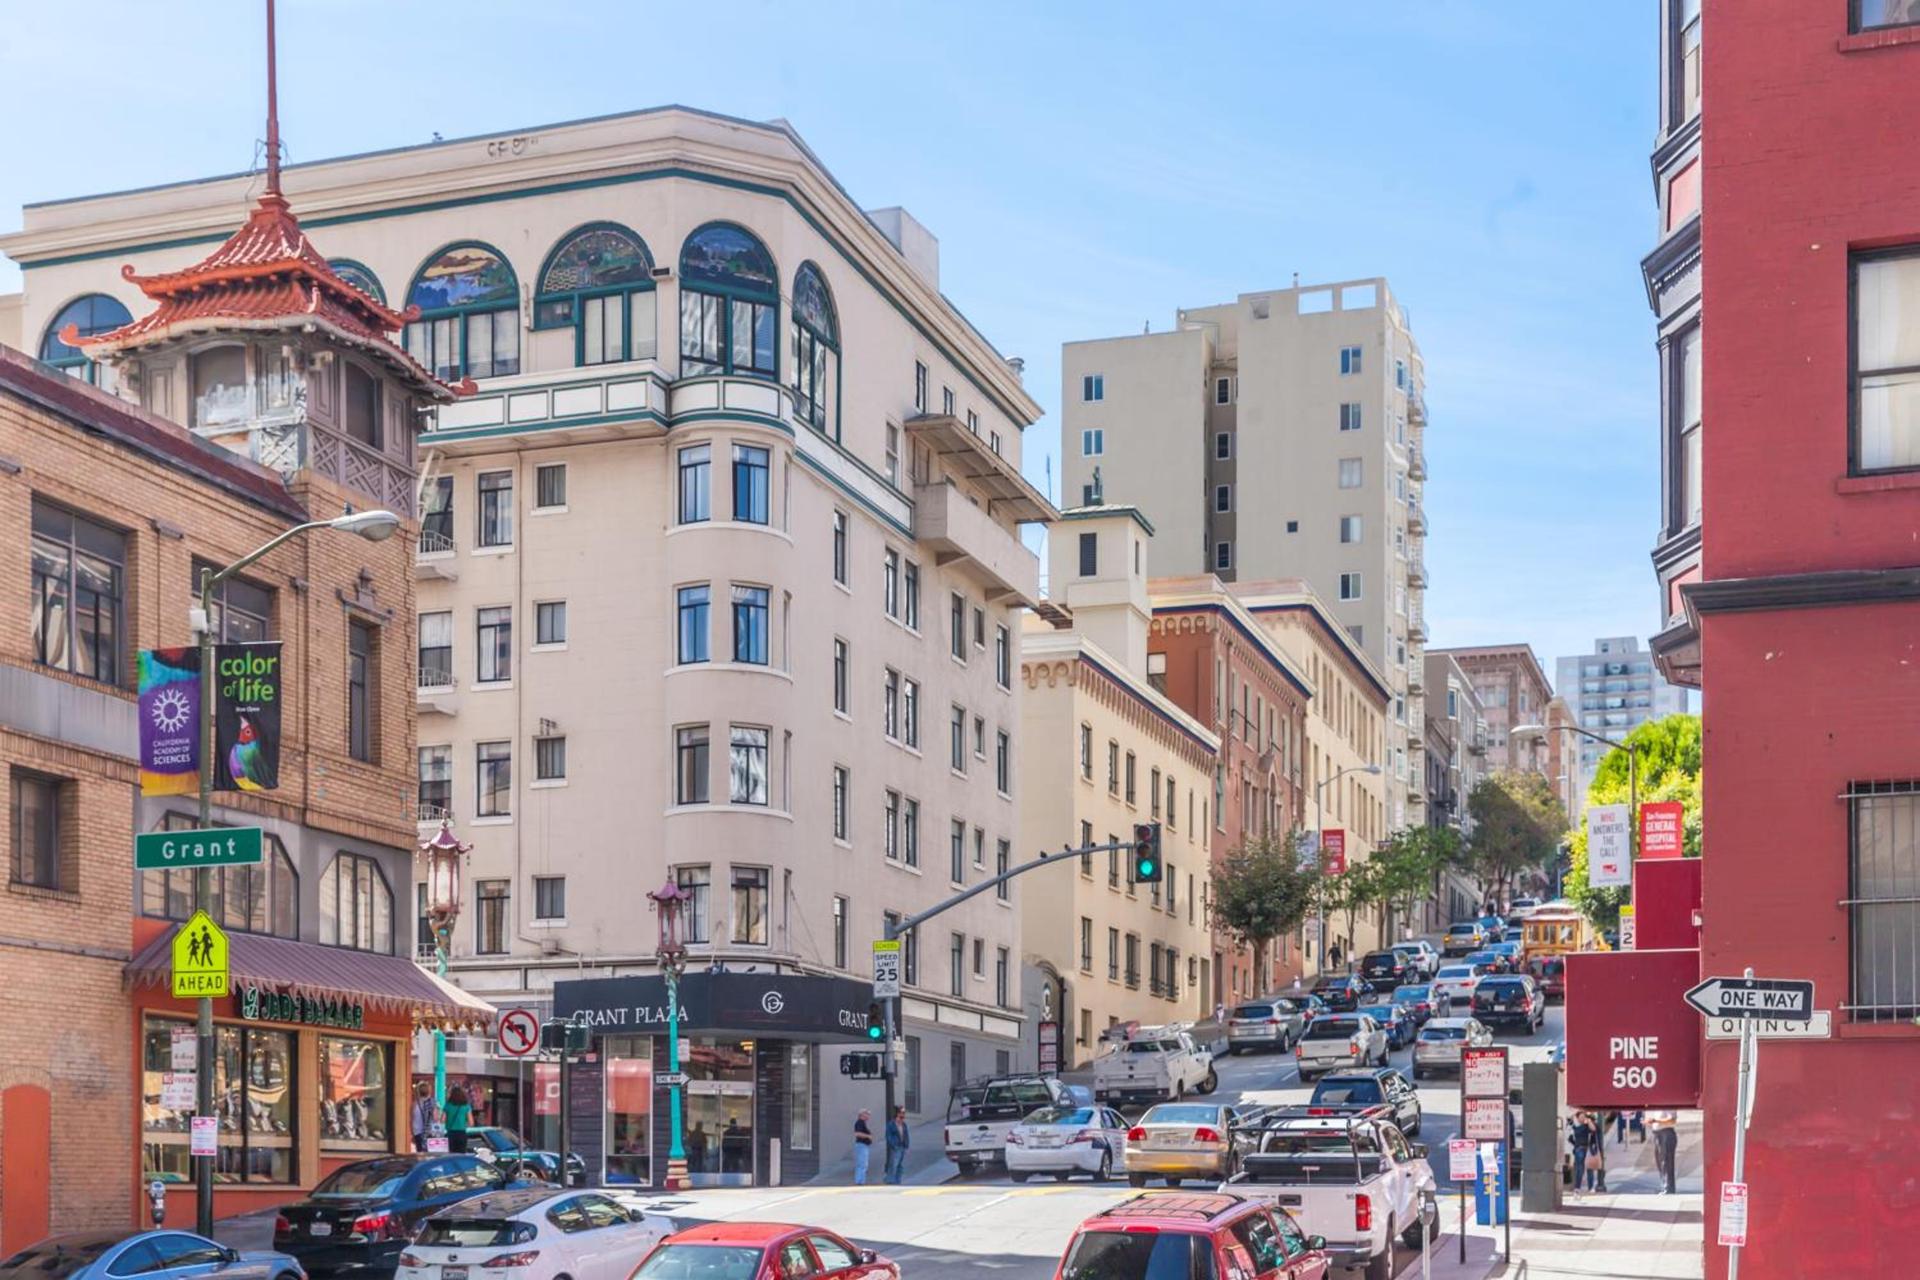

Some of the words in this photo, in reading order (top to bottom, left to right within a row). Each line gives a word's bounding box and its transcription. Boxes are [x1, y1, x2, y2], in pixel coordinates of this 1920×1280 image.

[220, 650, 278, 676] color
[223, 681, 237, 697] of
[239, 678, 274, 701] life
[181, 745, 190, 753] OF
[153, 753, 191, 765] SCIENCES
[1646, 820, 1676, 833] GENERAL
[1602, 836, 1615, 846] THE
[1646, 832, 1676, 845] HOSPITAL
[161, 838, 236, 859] Grant
[178, 975, 223, 990] AHEAD
[876, 968, 898, 981] 25
[1720, 990, 1756, 1006] ONE
[1763, 992, 1799, 1008] WAY
[572, 1007, 628, 1026] GRANT
[839, 1009, 869, 1030] GRANT
[1610, 1036, 1659, 1060] PINE
[1612, 1066, 1657, 1088] 560
[1466, 1099, 1477, 1111] NO
